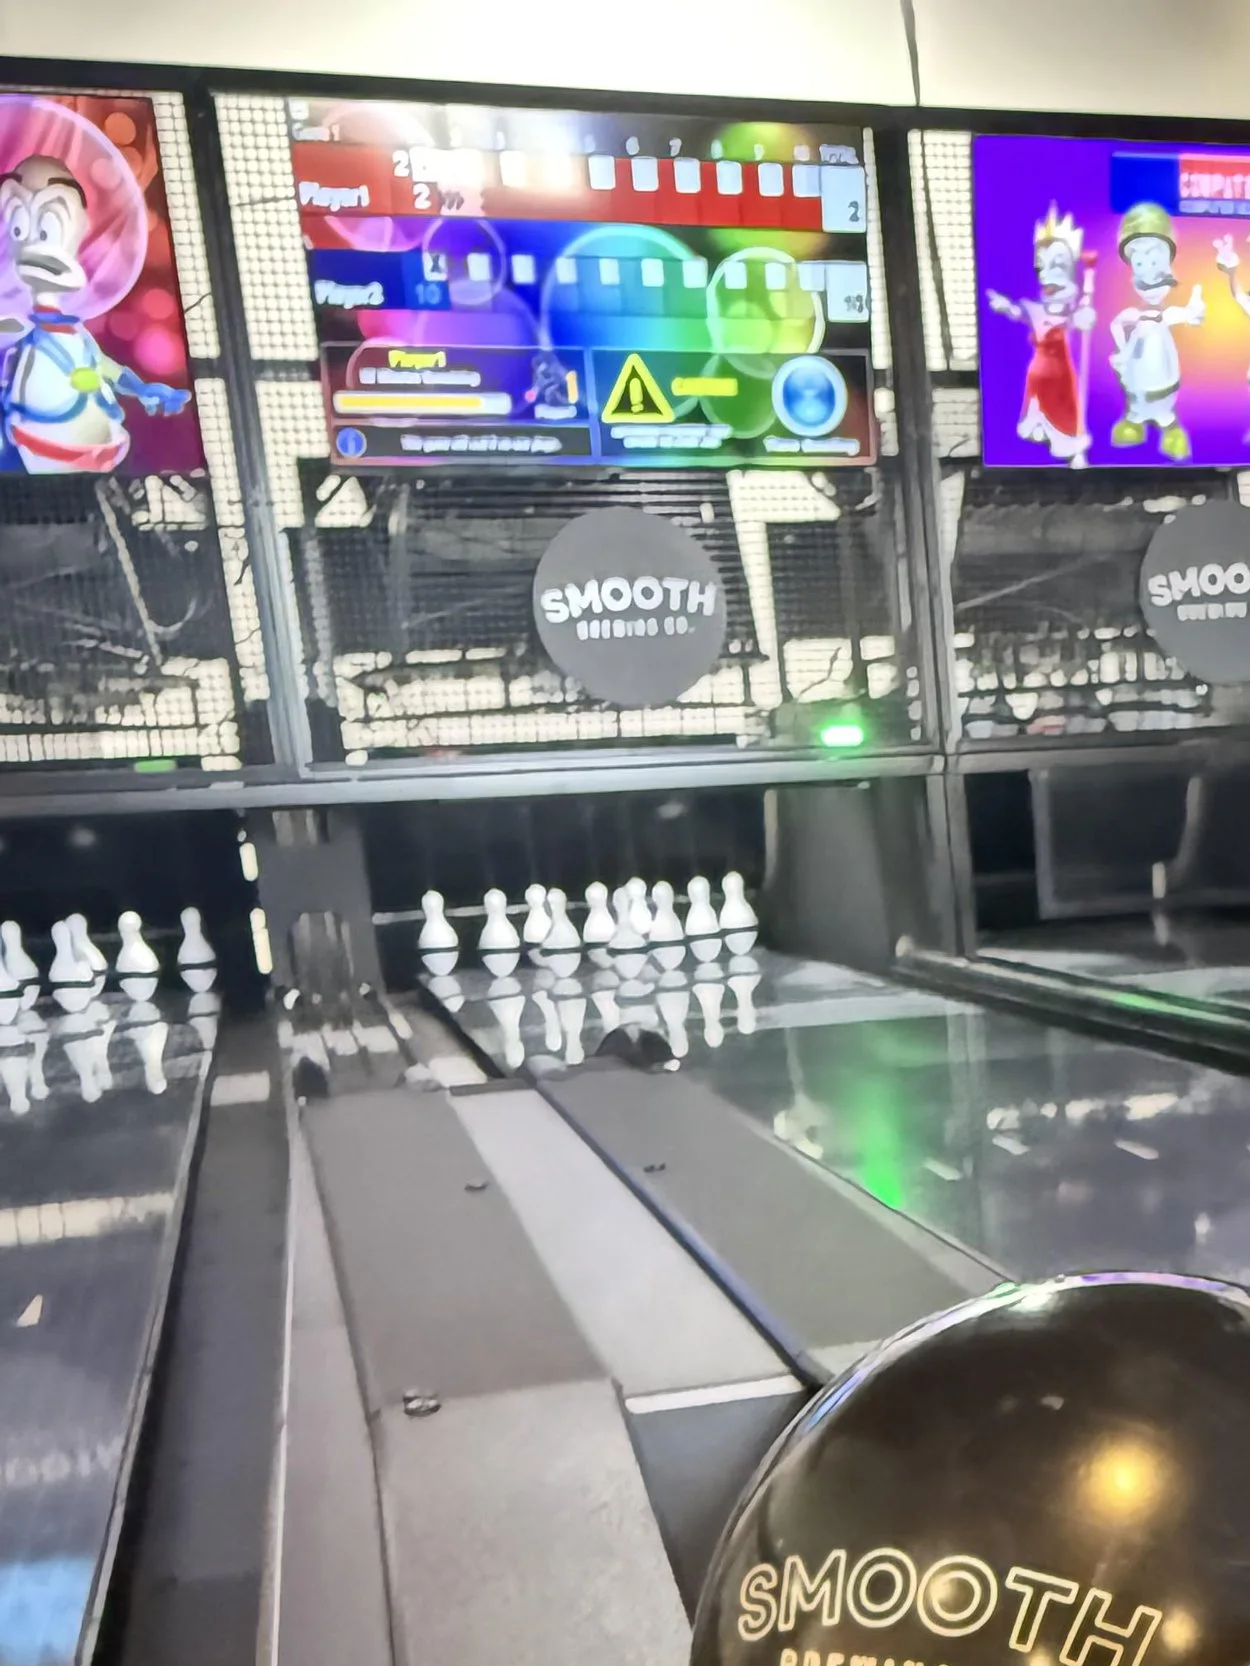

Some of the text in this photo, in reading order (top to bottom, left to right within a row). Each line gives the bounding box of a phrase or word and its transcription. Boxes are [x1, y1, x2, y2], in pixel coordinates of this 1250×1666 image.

[392, 150, 410, 177] 2
[412, 183, 432, 210] 2
[848, 200, 860, 222] 2
[540, 576, 718, 623] SMOOTH
